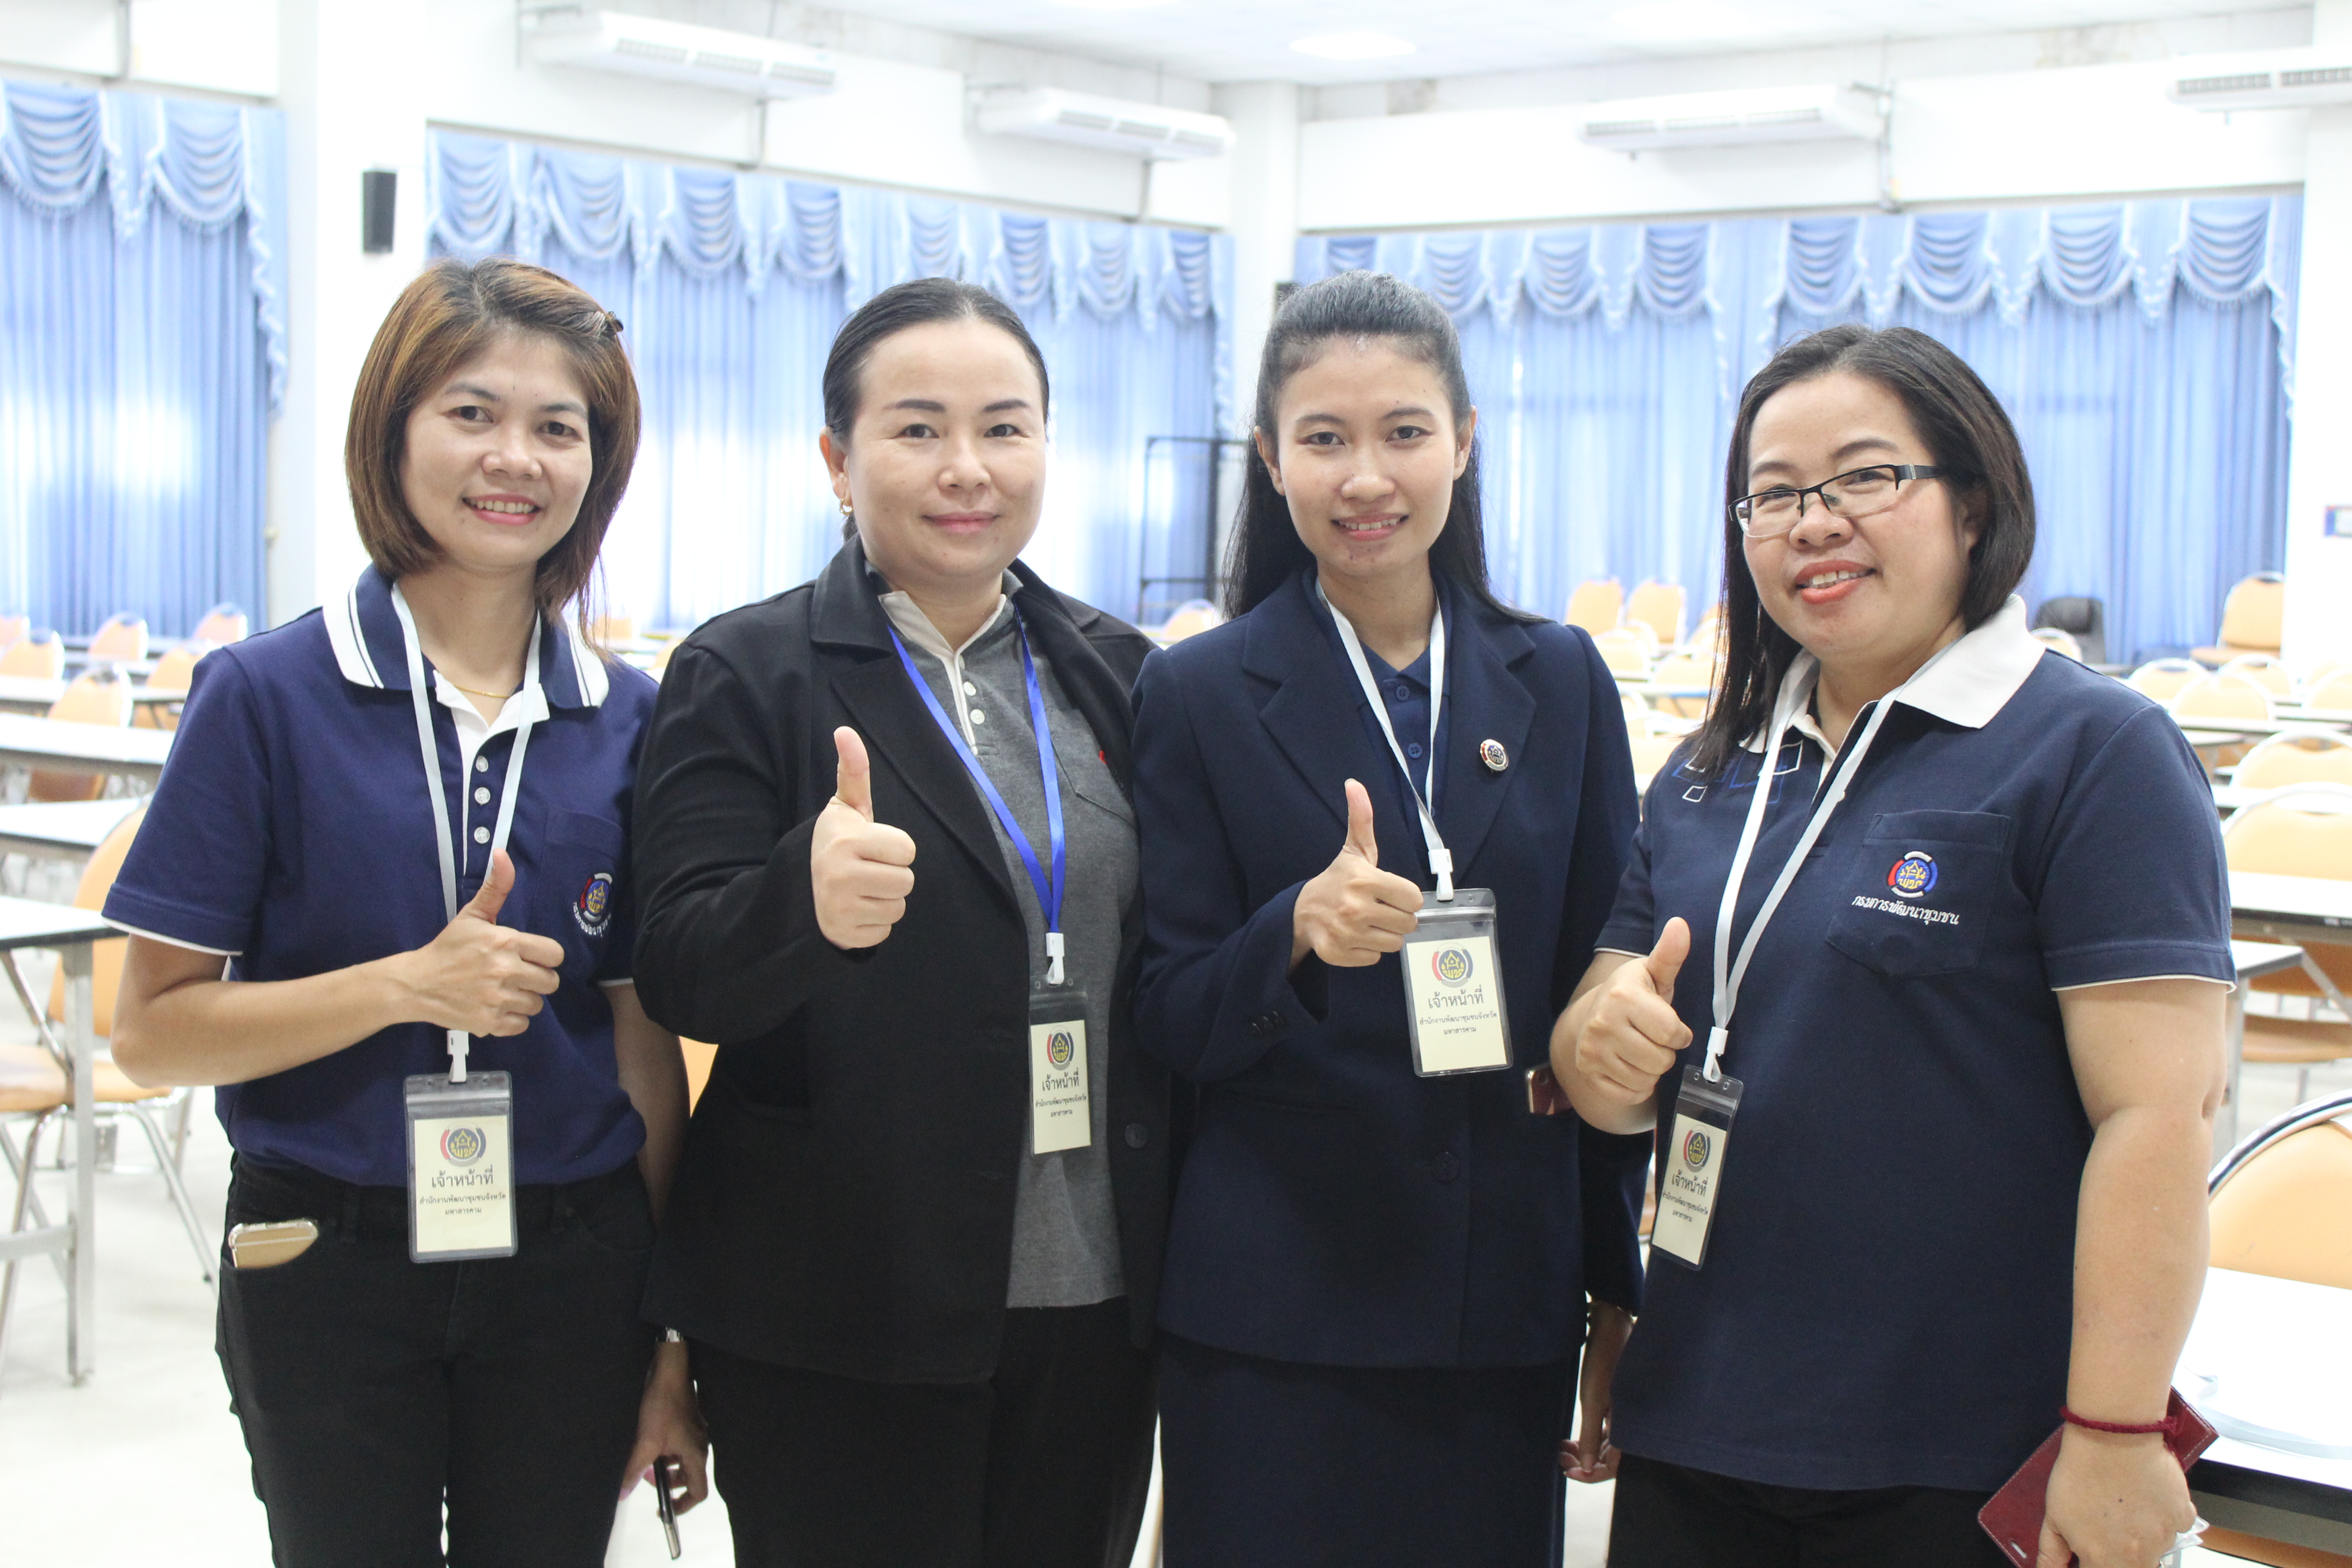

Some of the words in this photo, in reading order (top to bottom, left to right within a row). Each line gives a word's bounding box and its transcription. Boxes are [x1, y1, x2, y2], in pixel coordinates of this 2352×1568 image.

[1852, 895, 1960, 925] กรมการพัฒนาชุมชน
[1428, 984, 1484, 1009] เจ้าหน้าที่
[1042, 1067, 1079, 1091] เจ้าหน้าที่
[431, 1164, 494, 1188] เจ้าหน้าที่
[1671, 1169, 1709, 1197] เจ้าหน้าที่
